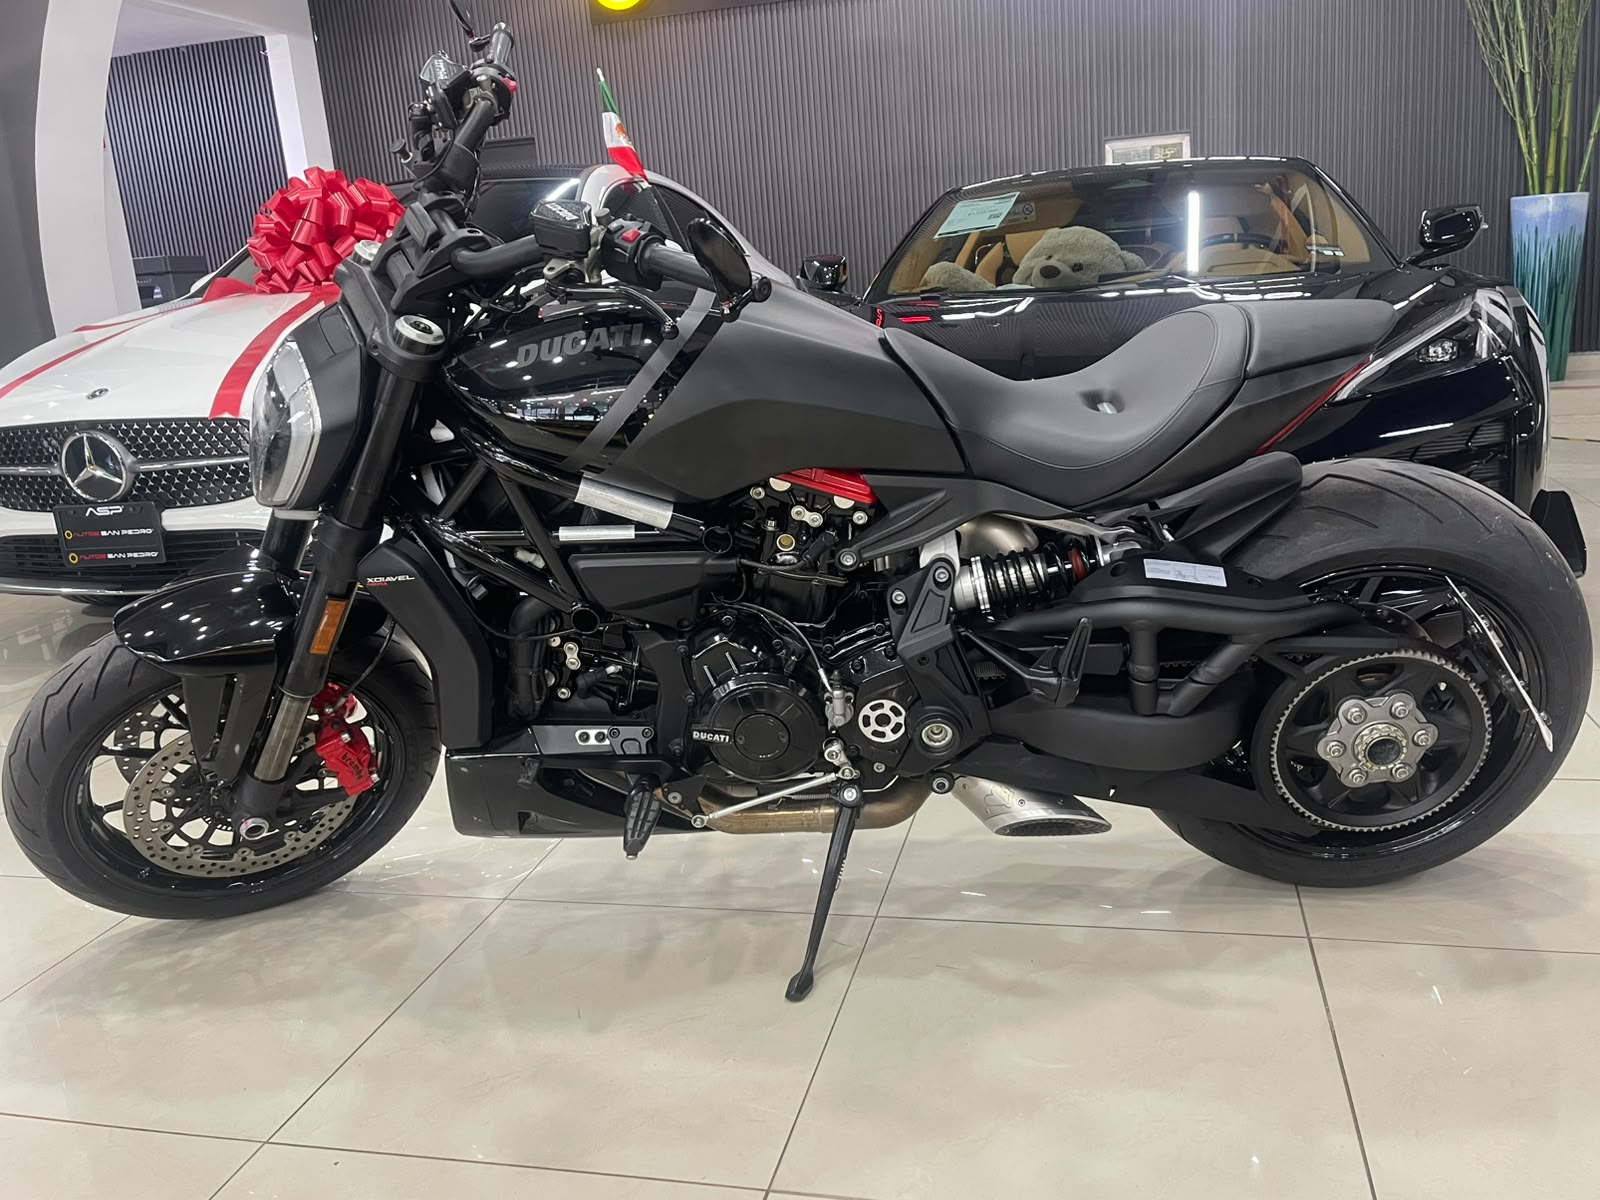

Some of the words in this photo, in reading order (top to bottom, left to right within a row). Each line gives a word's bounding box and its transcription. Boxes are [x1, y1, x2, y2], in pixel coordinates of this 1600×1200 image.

[516, 323, 643, 369] DUCATI
[101, 529, 120, 537] SAN
[366, 575, 415, 583] XDIAVEL
[692, 731, 730, 743] DUCATI
[341, 751, 364, 780] brembo
